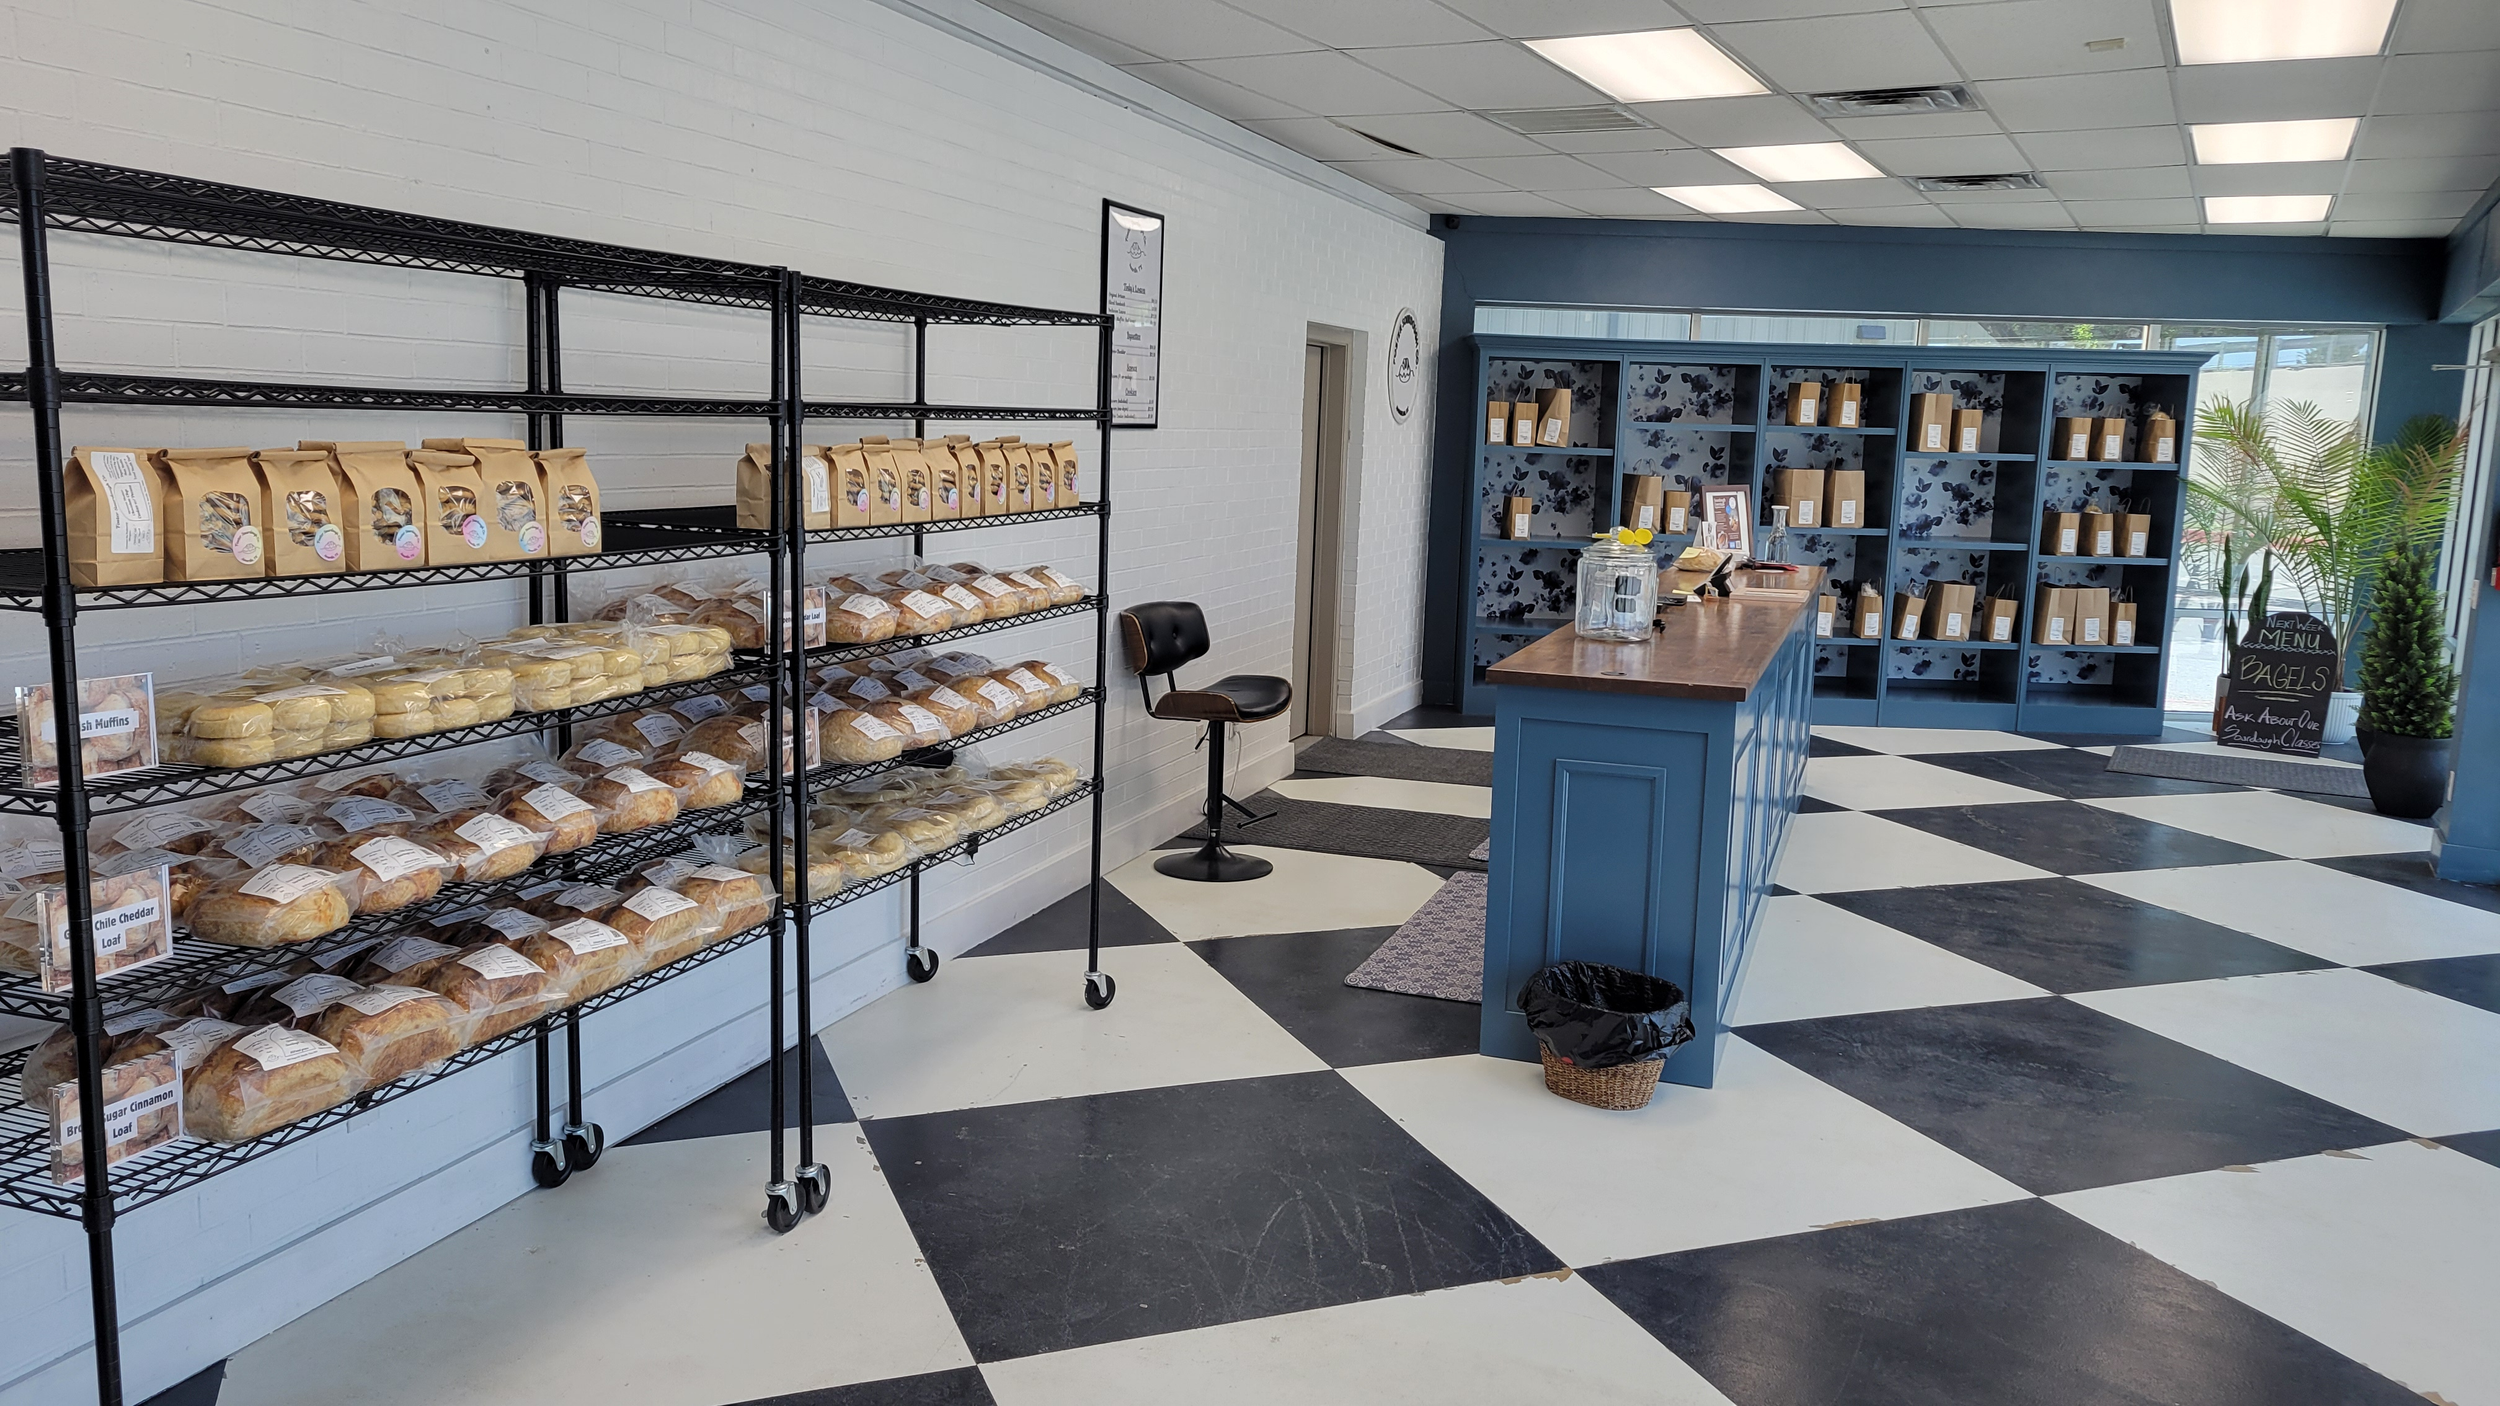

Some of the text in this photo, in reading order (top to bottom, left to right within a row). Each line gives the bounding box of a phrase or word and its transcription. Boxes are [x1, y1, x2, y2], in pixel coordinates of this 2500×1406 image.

[2259, 629, 2321, 650] MENU
[2239, 654, 2330, 692] BAGELS
[95, 715, 130, 732] Muffins
[2224, 705, 2321, 731] ASK ABOUT OUR
[2221, 724, 2322, 750] Sourdough Classes
[94, 905, 155, 931] Chile Cheddar
[101, 933, 122, 949] Loaf
[66, 1123, 82, 1138] Bro
[129, 1089, 174, 1113] Cinnamon
[112, 1122, 133, 1139] Loaf
